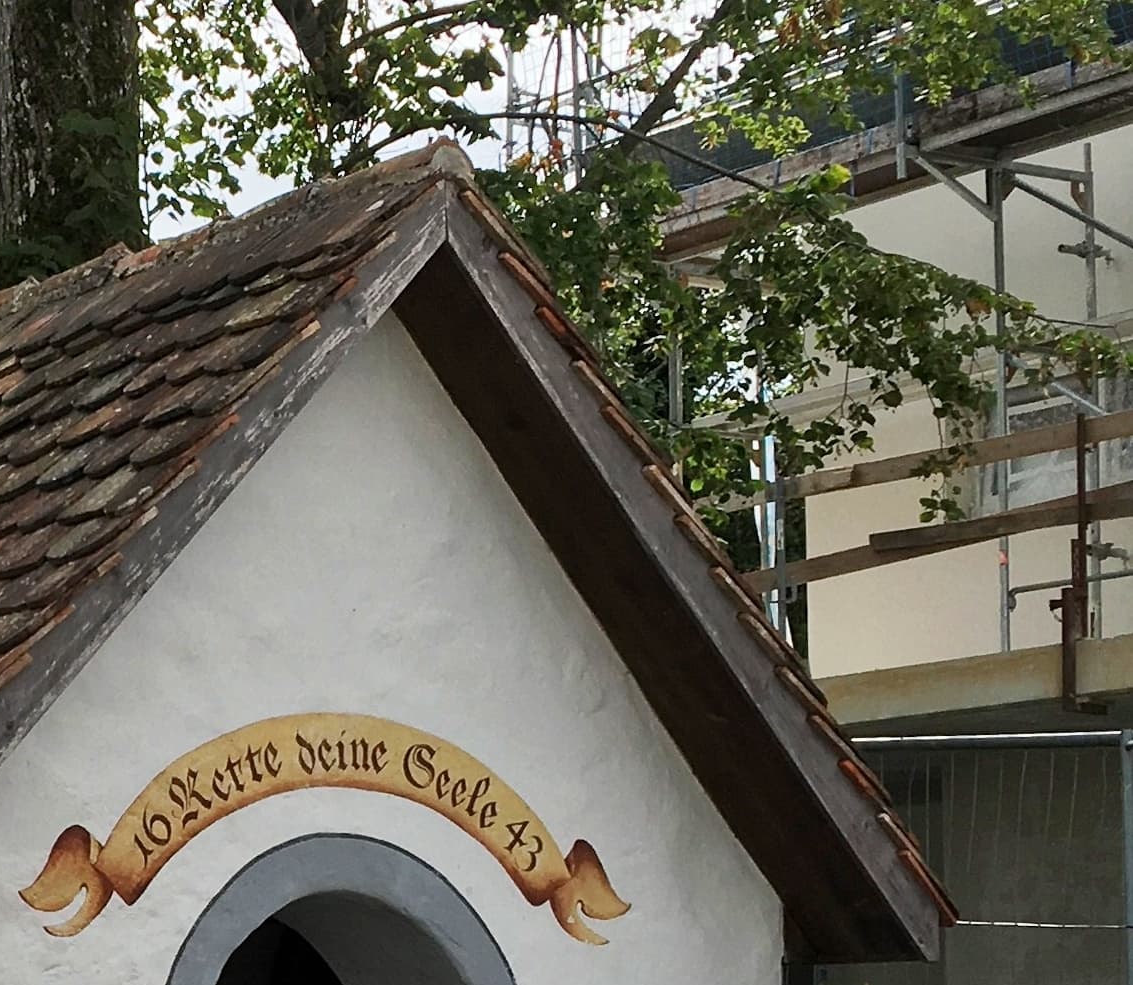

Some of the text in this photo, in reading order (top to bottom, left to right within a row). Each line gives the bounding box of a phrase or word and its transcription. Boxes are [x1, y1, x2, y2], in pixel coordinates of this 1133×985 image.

[133, 730, 544, 872] 16 Rette deine Seele 43
